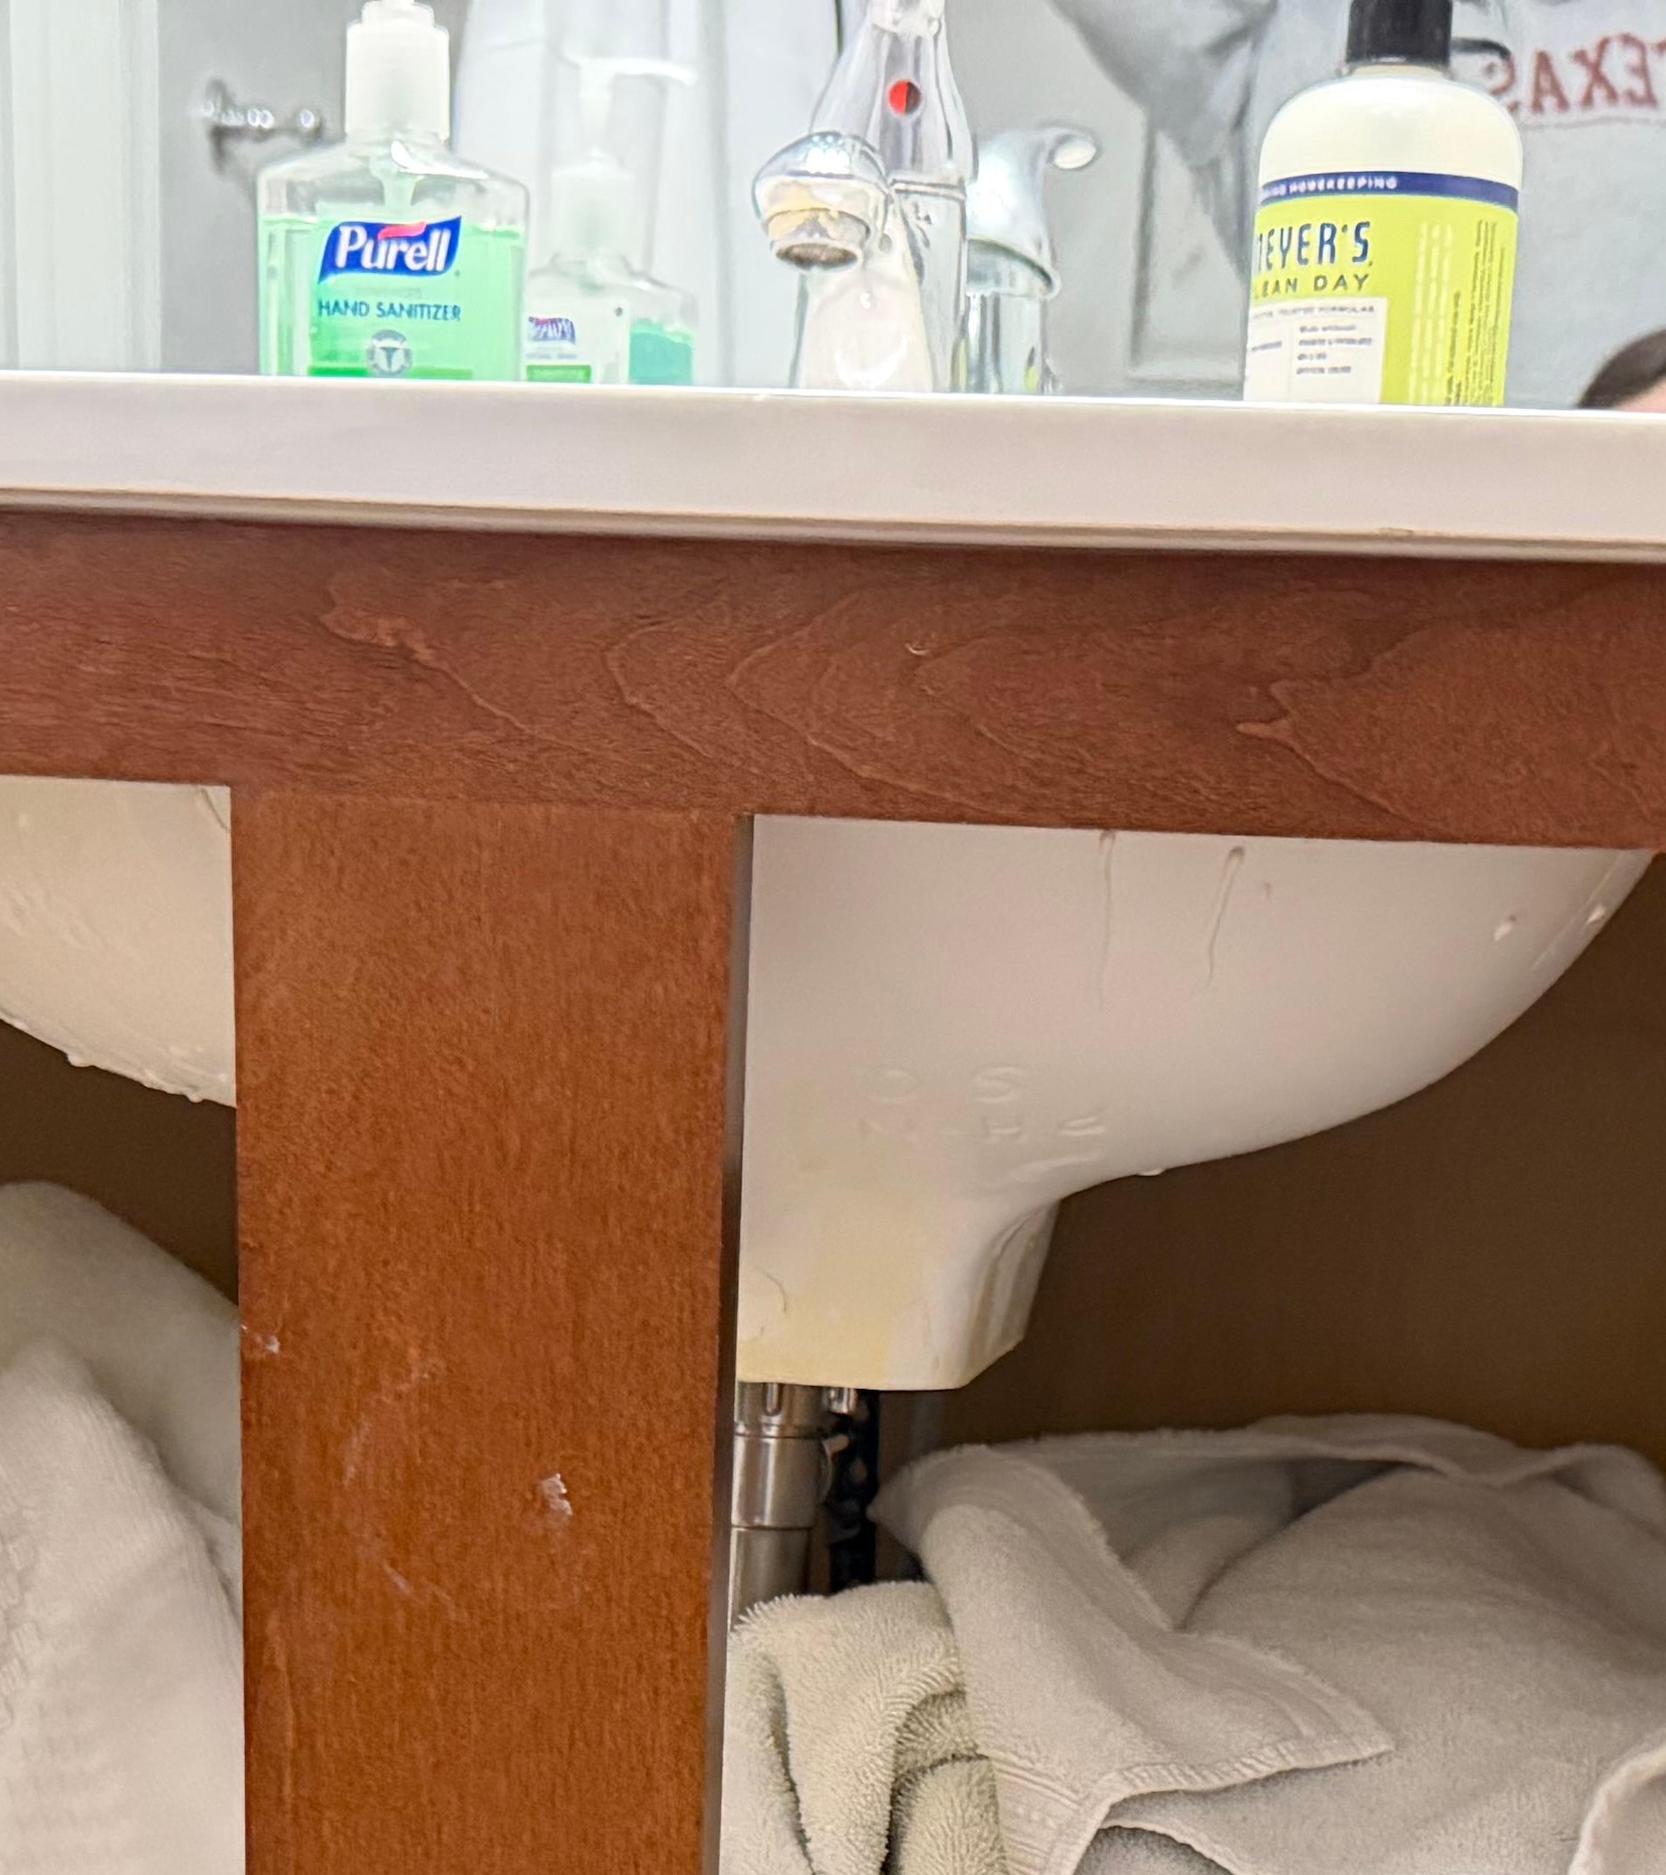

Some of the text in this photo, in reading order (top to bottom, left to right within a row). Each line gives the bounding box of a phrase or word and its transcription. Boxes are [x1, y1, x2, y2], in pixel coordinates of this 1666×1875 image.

[335, 225, 452, 271] Purell
[1313, 274, 1370, 292] DAY
[318, 299, 461, 321] HAND SANITIZER
